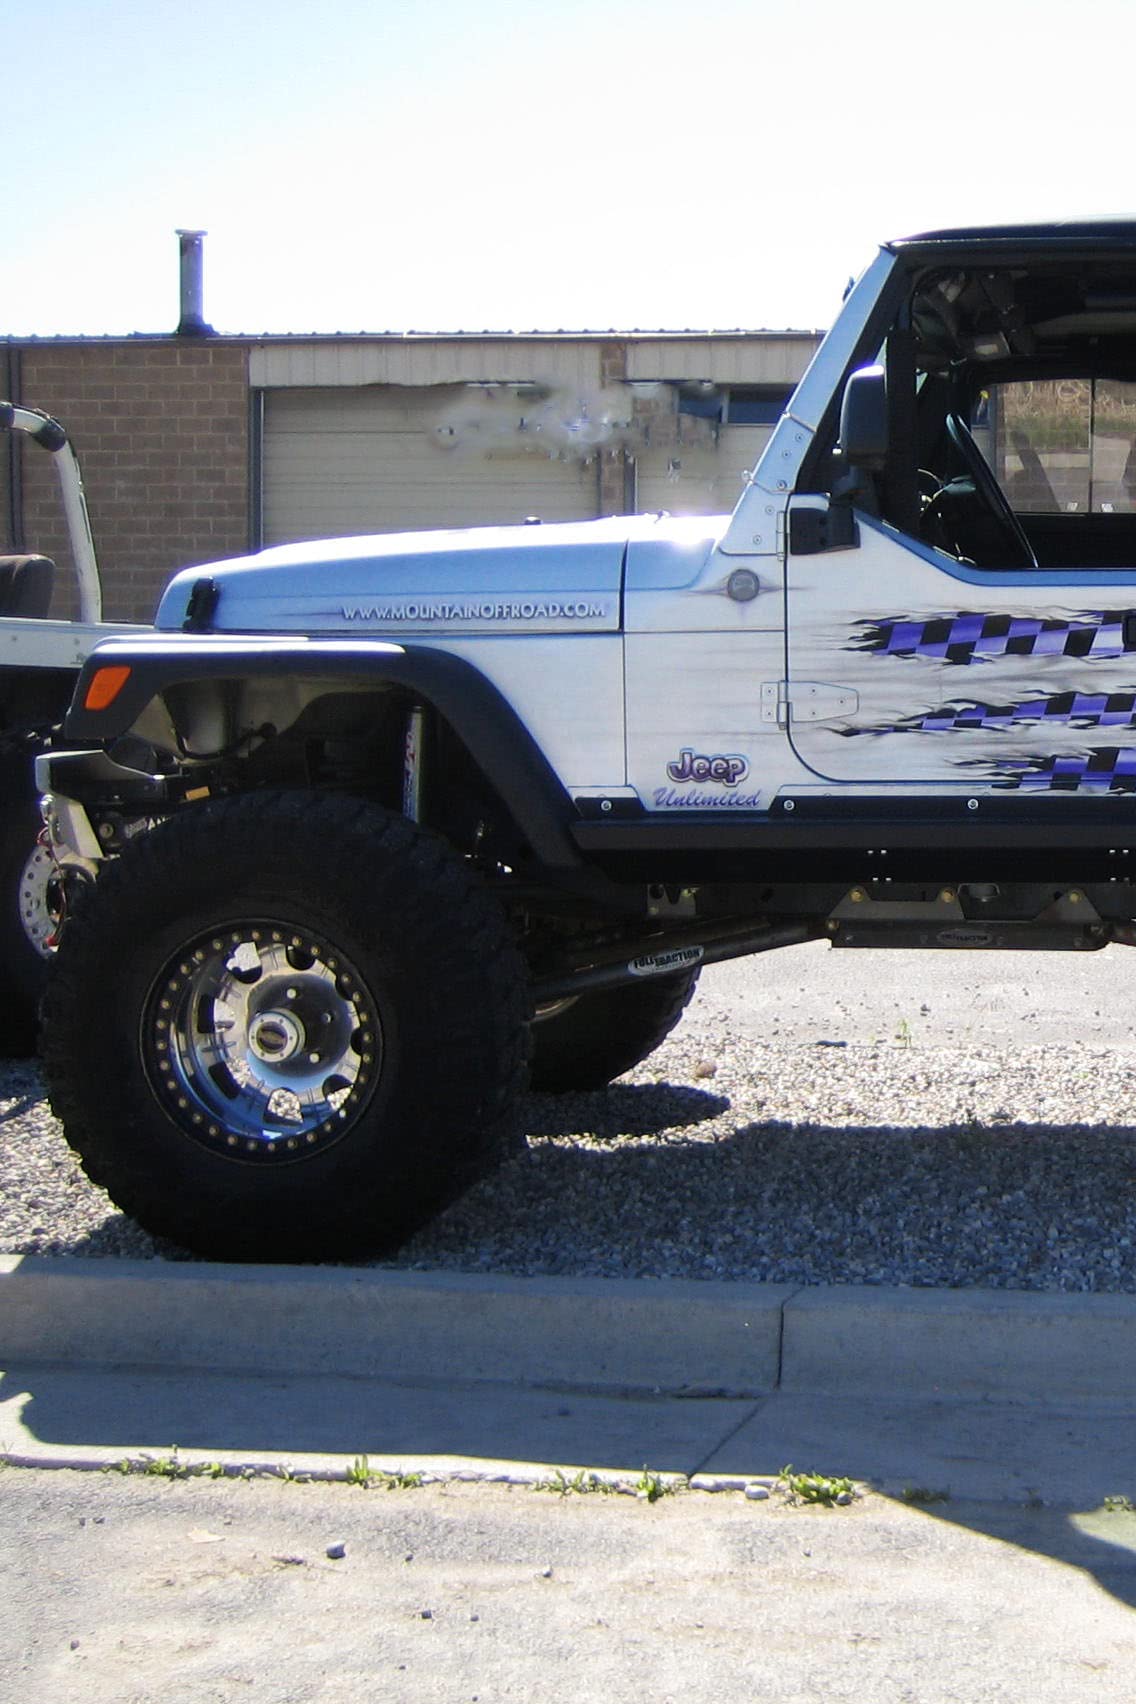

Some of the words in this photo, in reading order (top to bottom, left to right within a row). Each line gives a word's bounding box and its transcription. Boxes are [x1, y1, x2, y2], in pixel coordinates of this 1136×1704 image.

[341, 602, 606, 620] WWW.MOUNTAINOFFROAD.COM
[668, 750, 747, 785] Jeep
[653, 786, 761, 808] Unlimited
